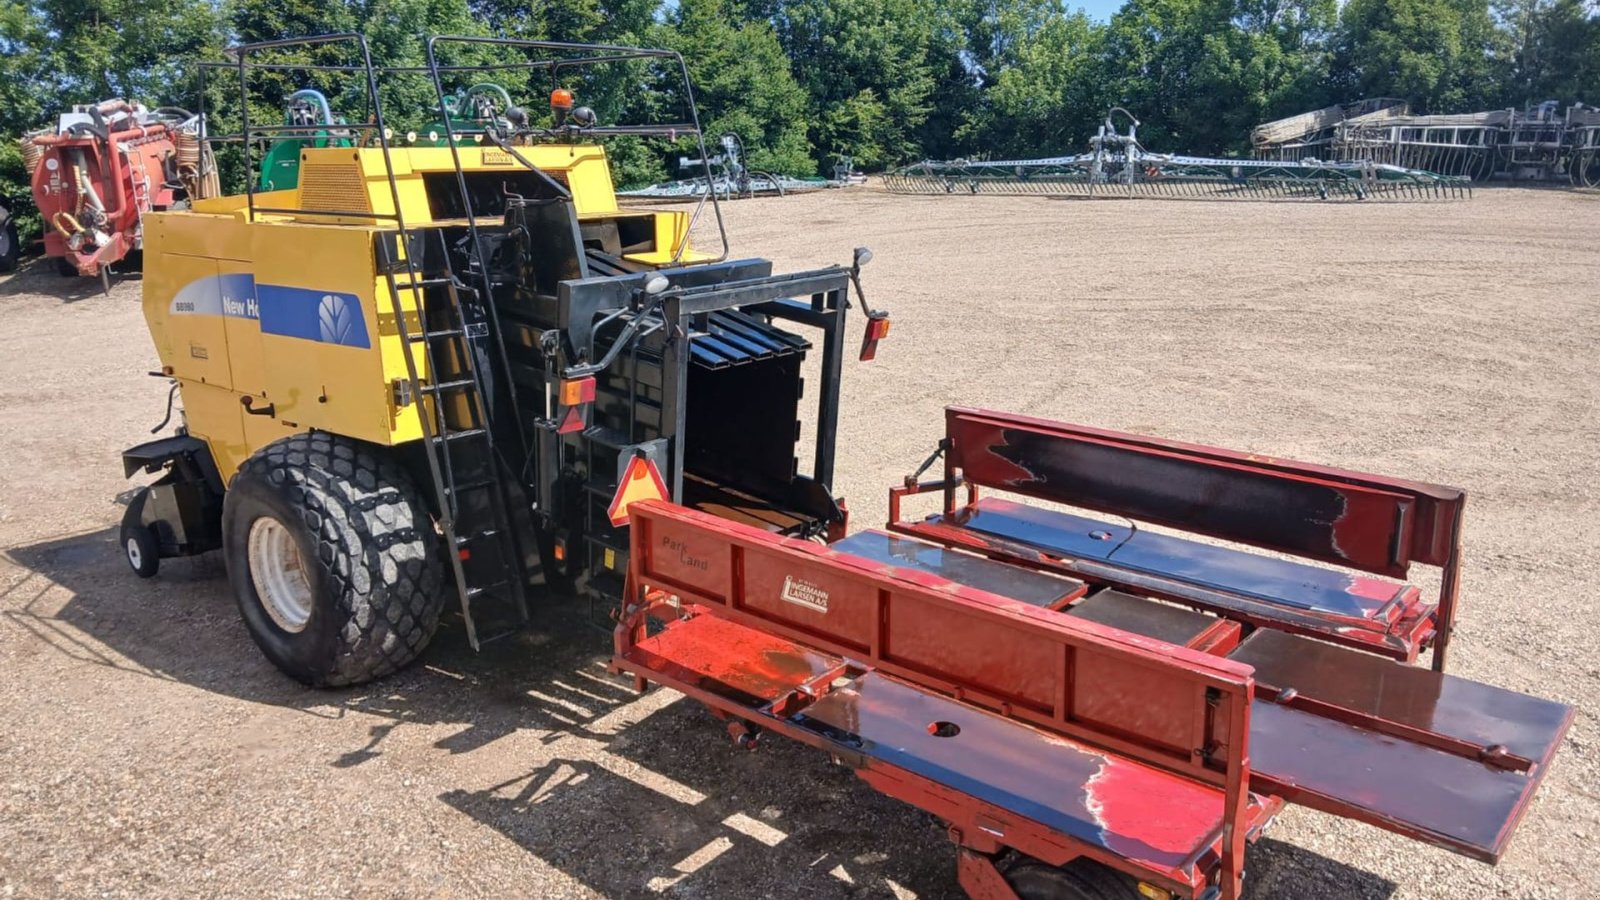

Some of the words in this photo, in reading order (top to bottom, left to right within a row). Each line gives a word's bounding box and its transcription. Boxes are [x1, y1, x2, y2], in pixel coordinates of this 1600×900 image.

[223, 296, 245, 315] New
[662, 536, 688, 553] Park
[680, 550, 708, 571] Land
[790, 590, 814, 603] LARSEN
